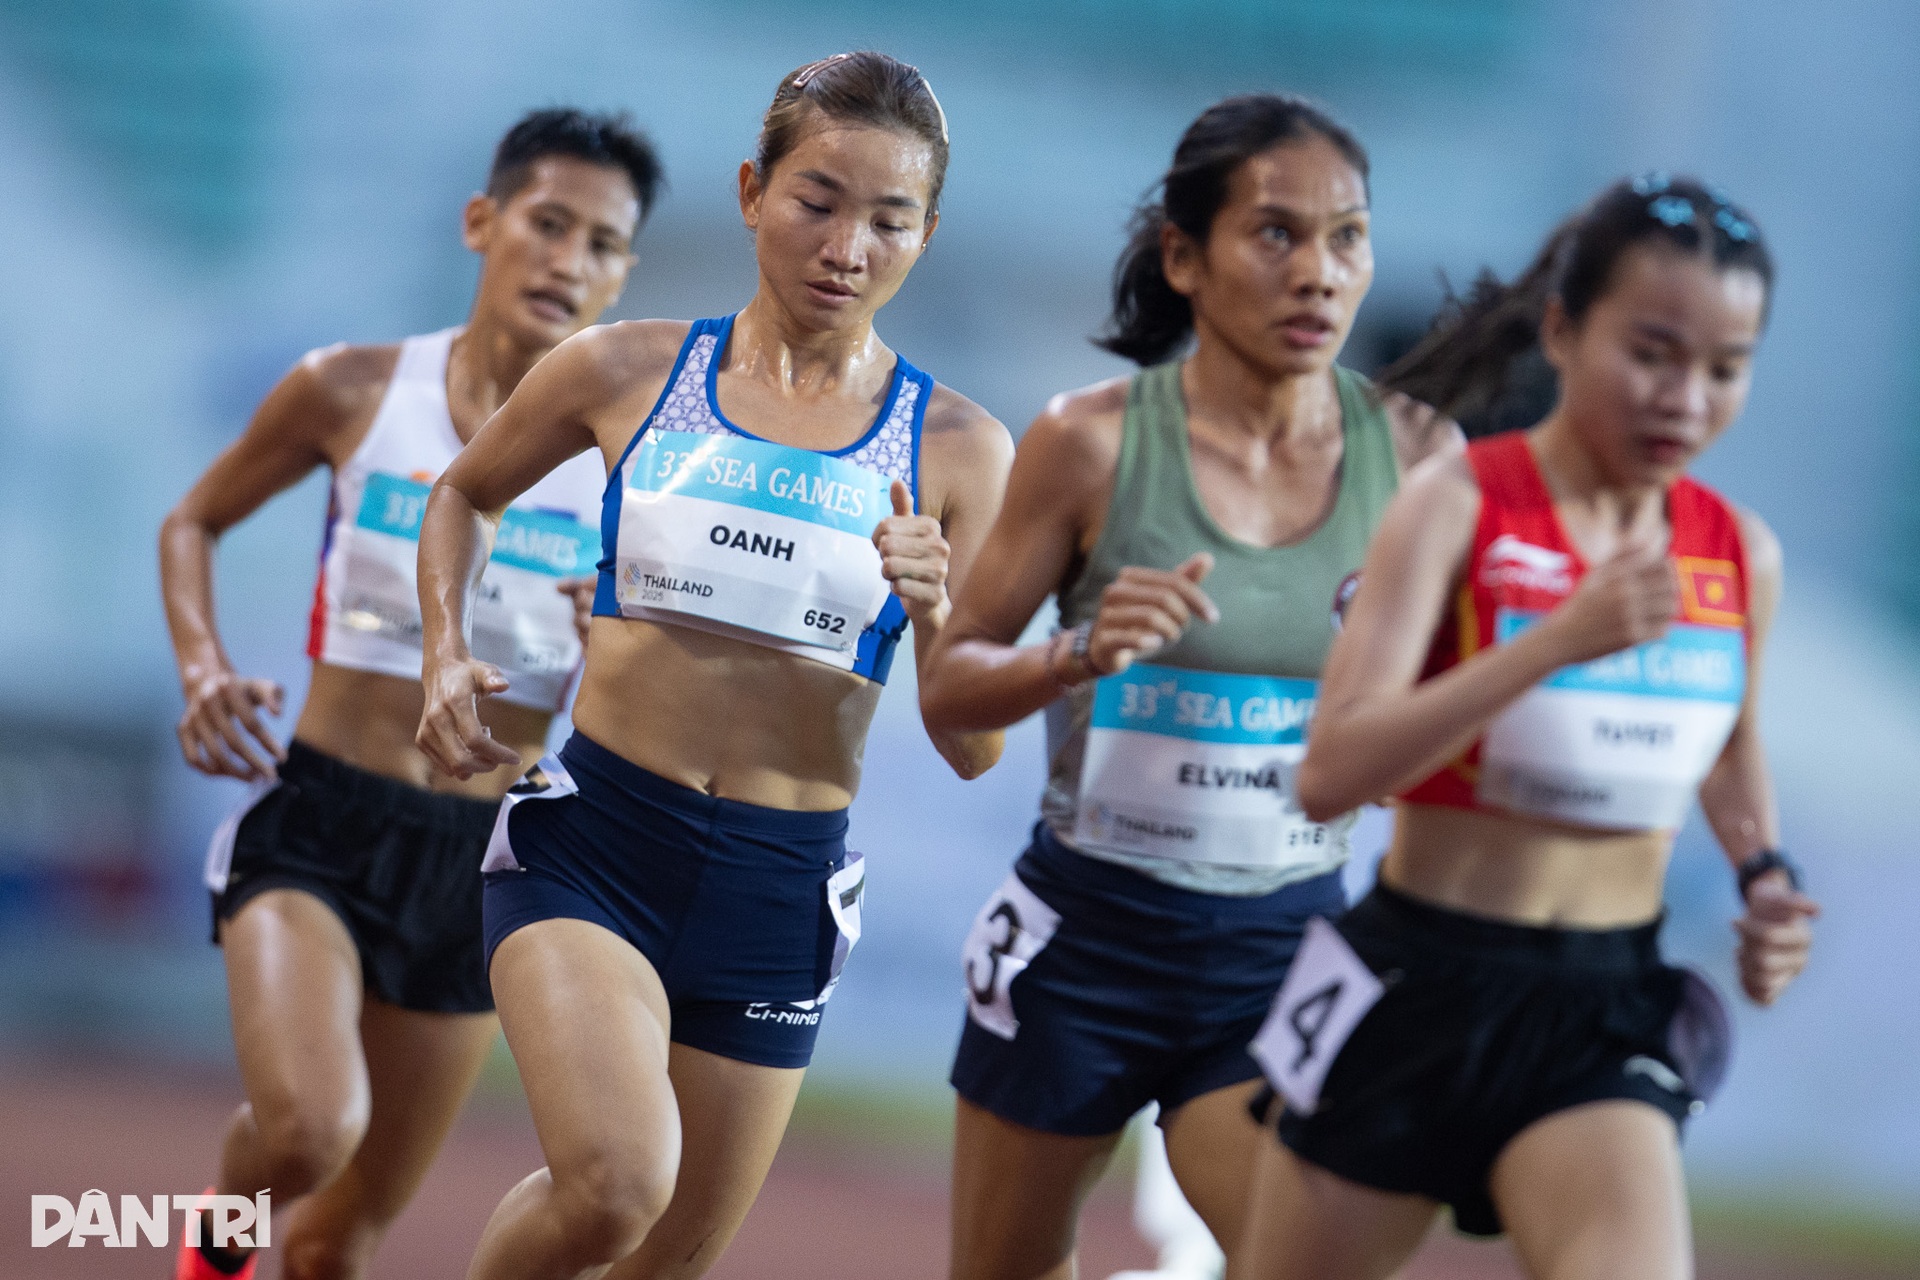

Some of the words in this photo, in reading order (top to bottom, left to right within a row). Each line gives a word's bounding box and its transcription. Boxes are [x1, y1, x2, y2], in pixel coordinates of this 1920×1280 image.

[706, 456, 758, 491] SEA
[768, 466, 866, 518] GAMES
[709, 524, 797, 563] OANH
[641, 588, 665, 602] 2025
[644, 574, 714, 598] THAILAND
[803, 609, 848, 634] 652
[1174, 691, 1234, 729] SEA
[1239, 696, 1316, 732] GAM
[1176, 762, 1281, 789] ELVINA
[966, 898, 1022, 1006] 3
[745, 1002, 821, 1026] LI-NING
[1289, 977, 1349, 1074] 4
